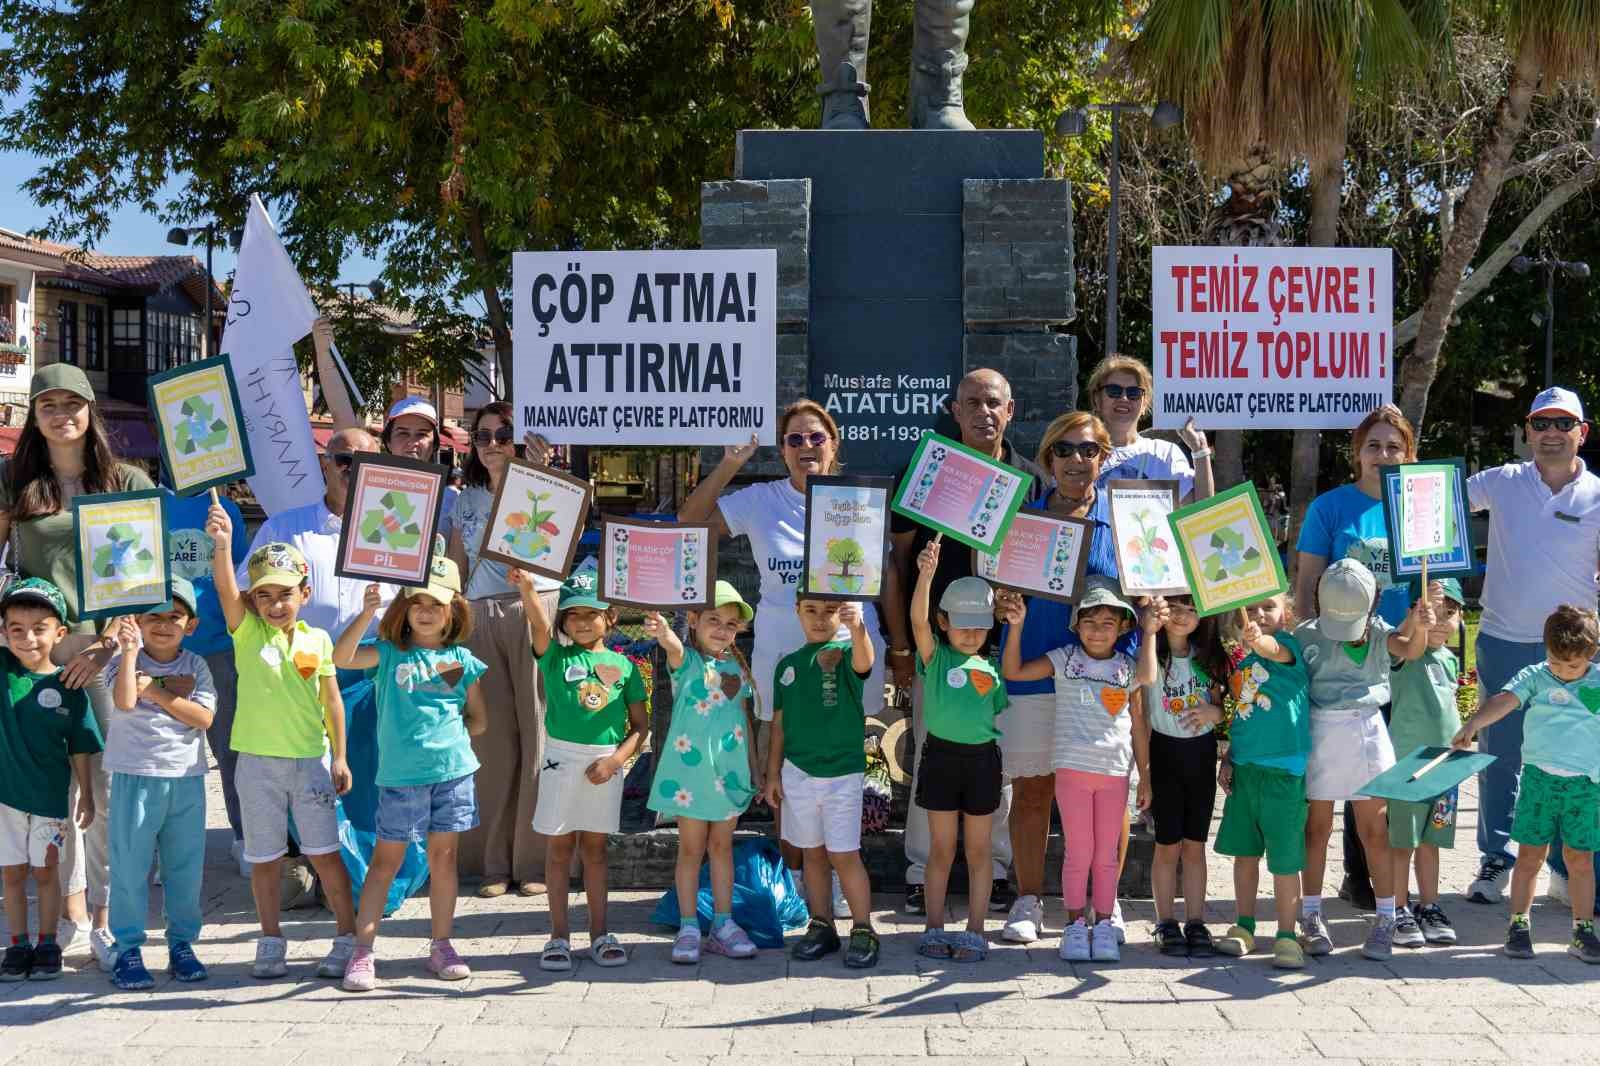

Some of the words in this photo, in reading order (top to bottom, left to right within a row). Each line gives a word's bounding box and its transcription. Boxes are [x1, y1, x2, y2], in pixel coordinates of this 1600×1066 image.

[531, 262, 614, 337] ÇÖP
[628, 272, 757, 323] ATMA!
[1171, 254, 1259, 313] TEMİZ
[1268, 266, 1359, 326] ÇEVRE
[1160, 320, 1249, 379] TEMİZ
[1257, 331, 1370, 379] TOPLUM
[544, 343, 742, 393] ATTIRMA!
[824, 374, 892, 389] Mustafa
[897, 374, 951, 389] Kemal
[825, 392, 950, 415] ATATÜRK
[1163, 393, 1244, 413] MANAVGAT
[1248, 392, 1295, 418] ÇEVRE
[524, 406, 607, 428] MANAVGAT
[613, 406, 664, 433] ÇEVRE
[669, 406, 764, 428] PLATFORMU
[373, 553, 398, 568] PİL
[1362, 563, 1389, 572] ARE
[572, 574, 595, 590] NY
